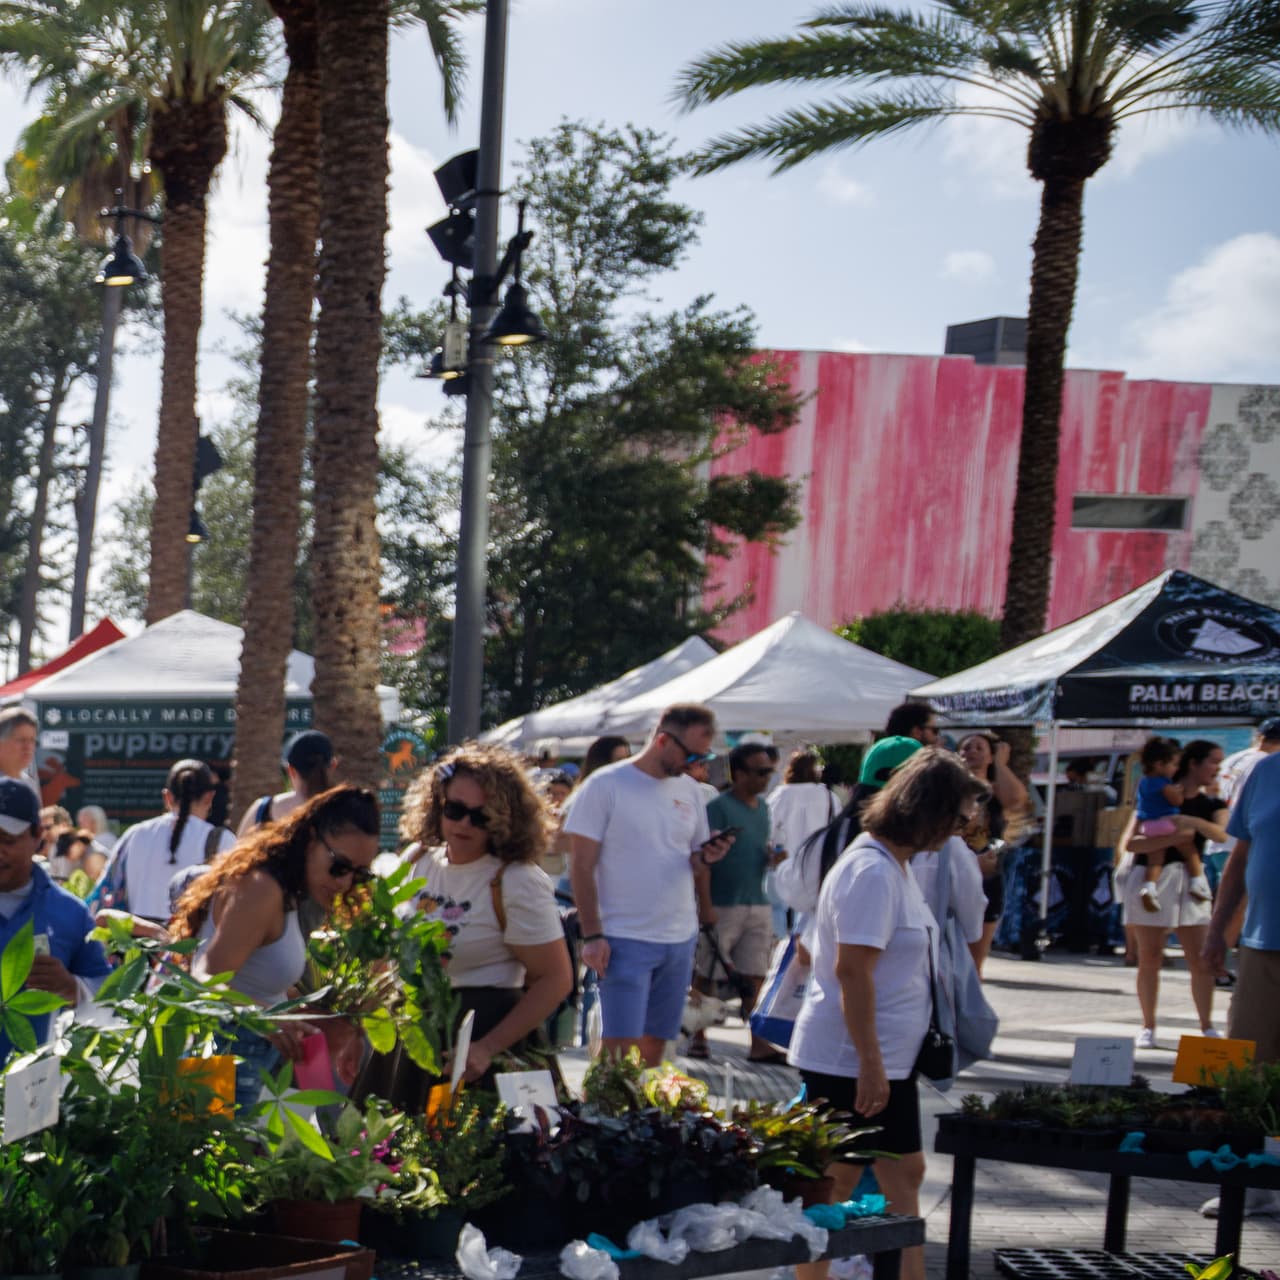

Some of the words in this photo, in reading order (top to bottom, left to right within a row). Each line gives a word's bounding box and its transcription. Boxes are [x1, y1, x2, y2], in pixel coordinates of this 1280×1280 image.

[1130, 684, 1194, 701] PALM
[1201, 683, 1280, 701] BEACH
[68, 708, 152, 721] LOCALLY
[161, 708, 215, 721] MADE
[85, 731, 236, 757] pupberry
